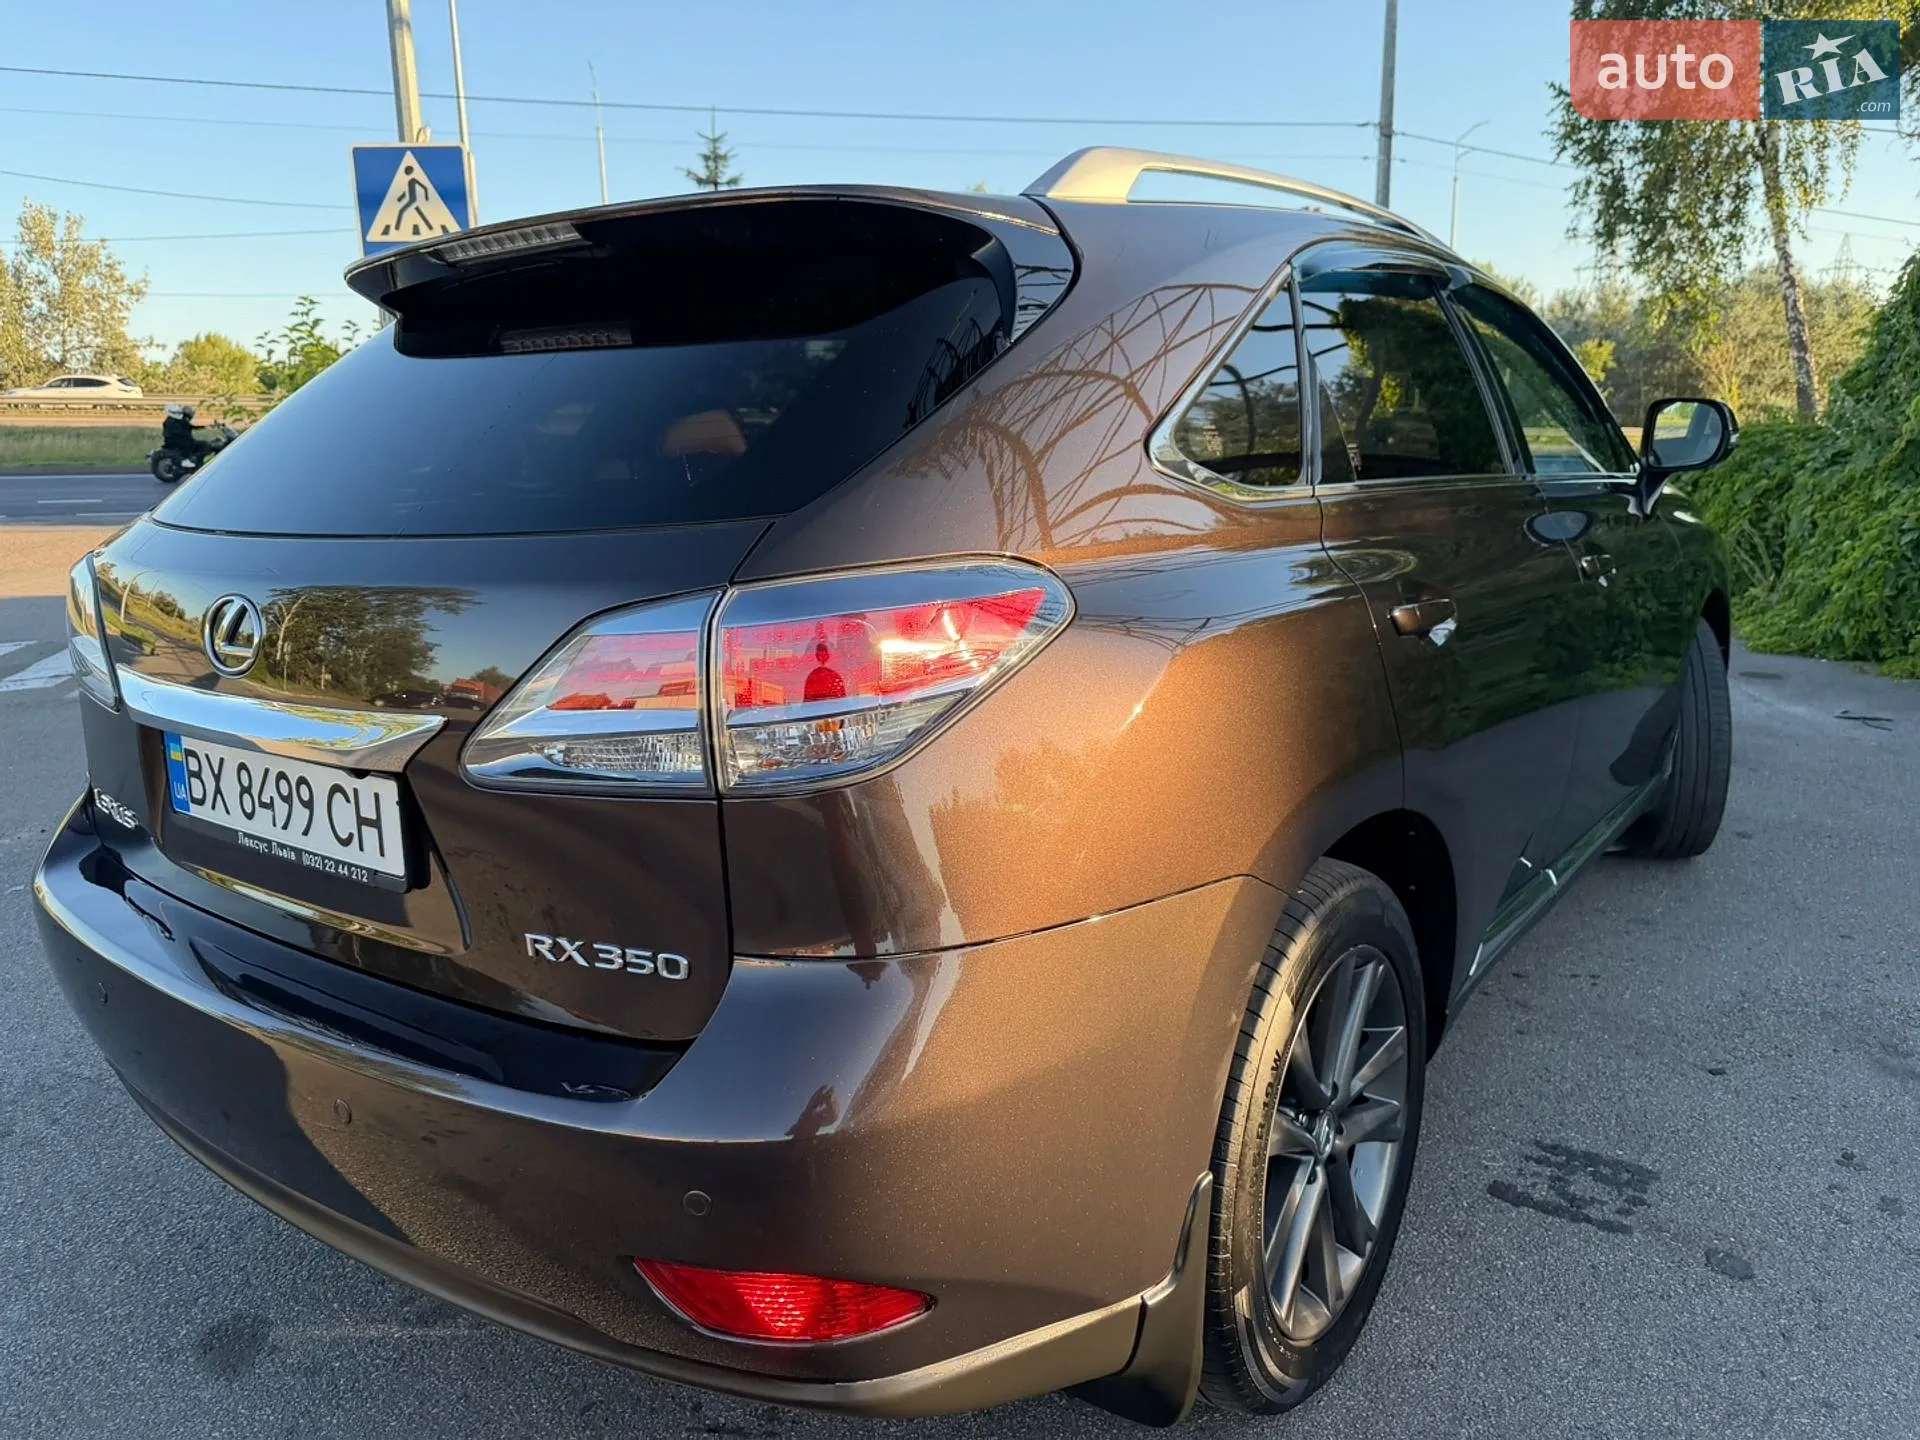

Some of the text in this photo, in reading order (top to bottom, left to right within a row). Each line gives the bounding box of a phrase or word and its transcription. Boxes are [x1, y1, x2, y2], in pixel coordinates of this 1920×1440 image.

[173, 781, 187, 801] UA
[184, 747, 385, 858] BX 8499 CH
[237, 831, 269, 853] Лексус
[301, 850, 323, 871] (032)
[324, 859, 336, 873] 22
[337, 863, 349, 877] 44
[350, 867, 368, 882] 212
[524, 932, 690, 980] RX 350
